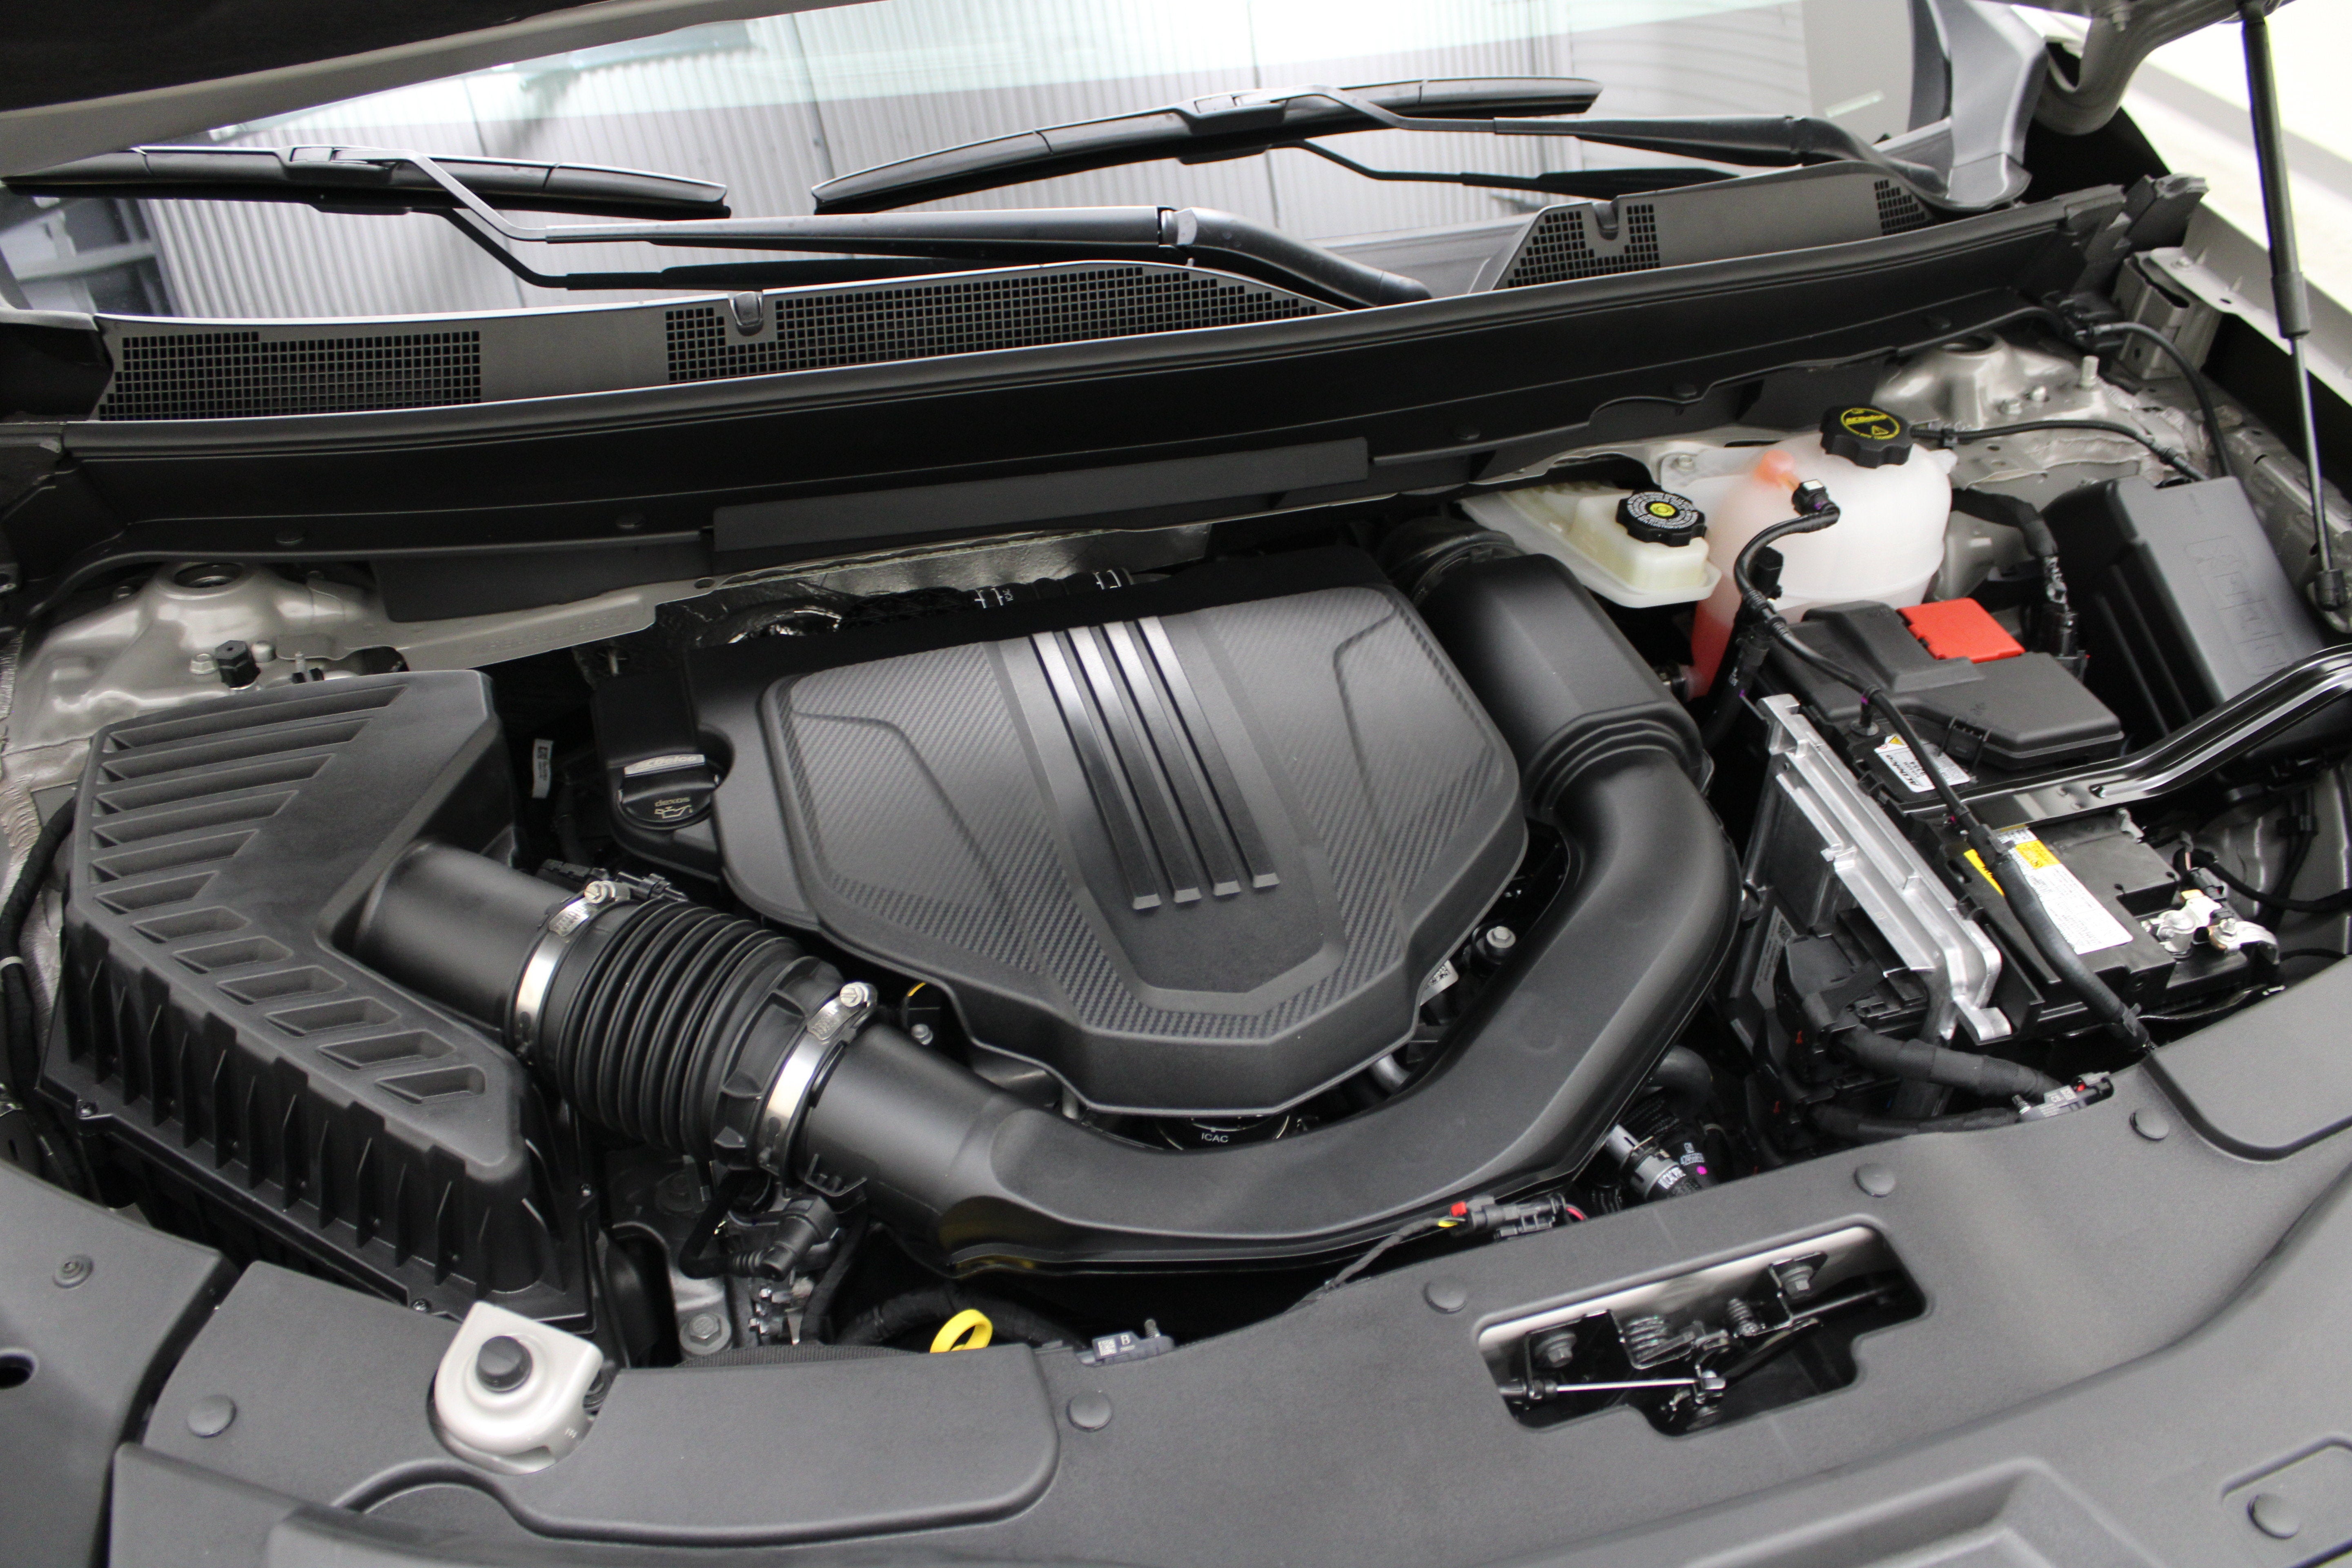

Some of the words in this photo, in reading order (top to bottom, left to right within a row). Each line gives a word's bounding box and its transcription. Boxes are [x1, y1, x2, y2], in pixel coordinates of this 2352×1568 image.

[1886, 755, 1919, 786] ACDelco
[1202, 1133, 1229, 1143] ICAC
[1120, 1334, 1131, 1345] B
